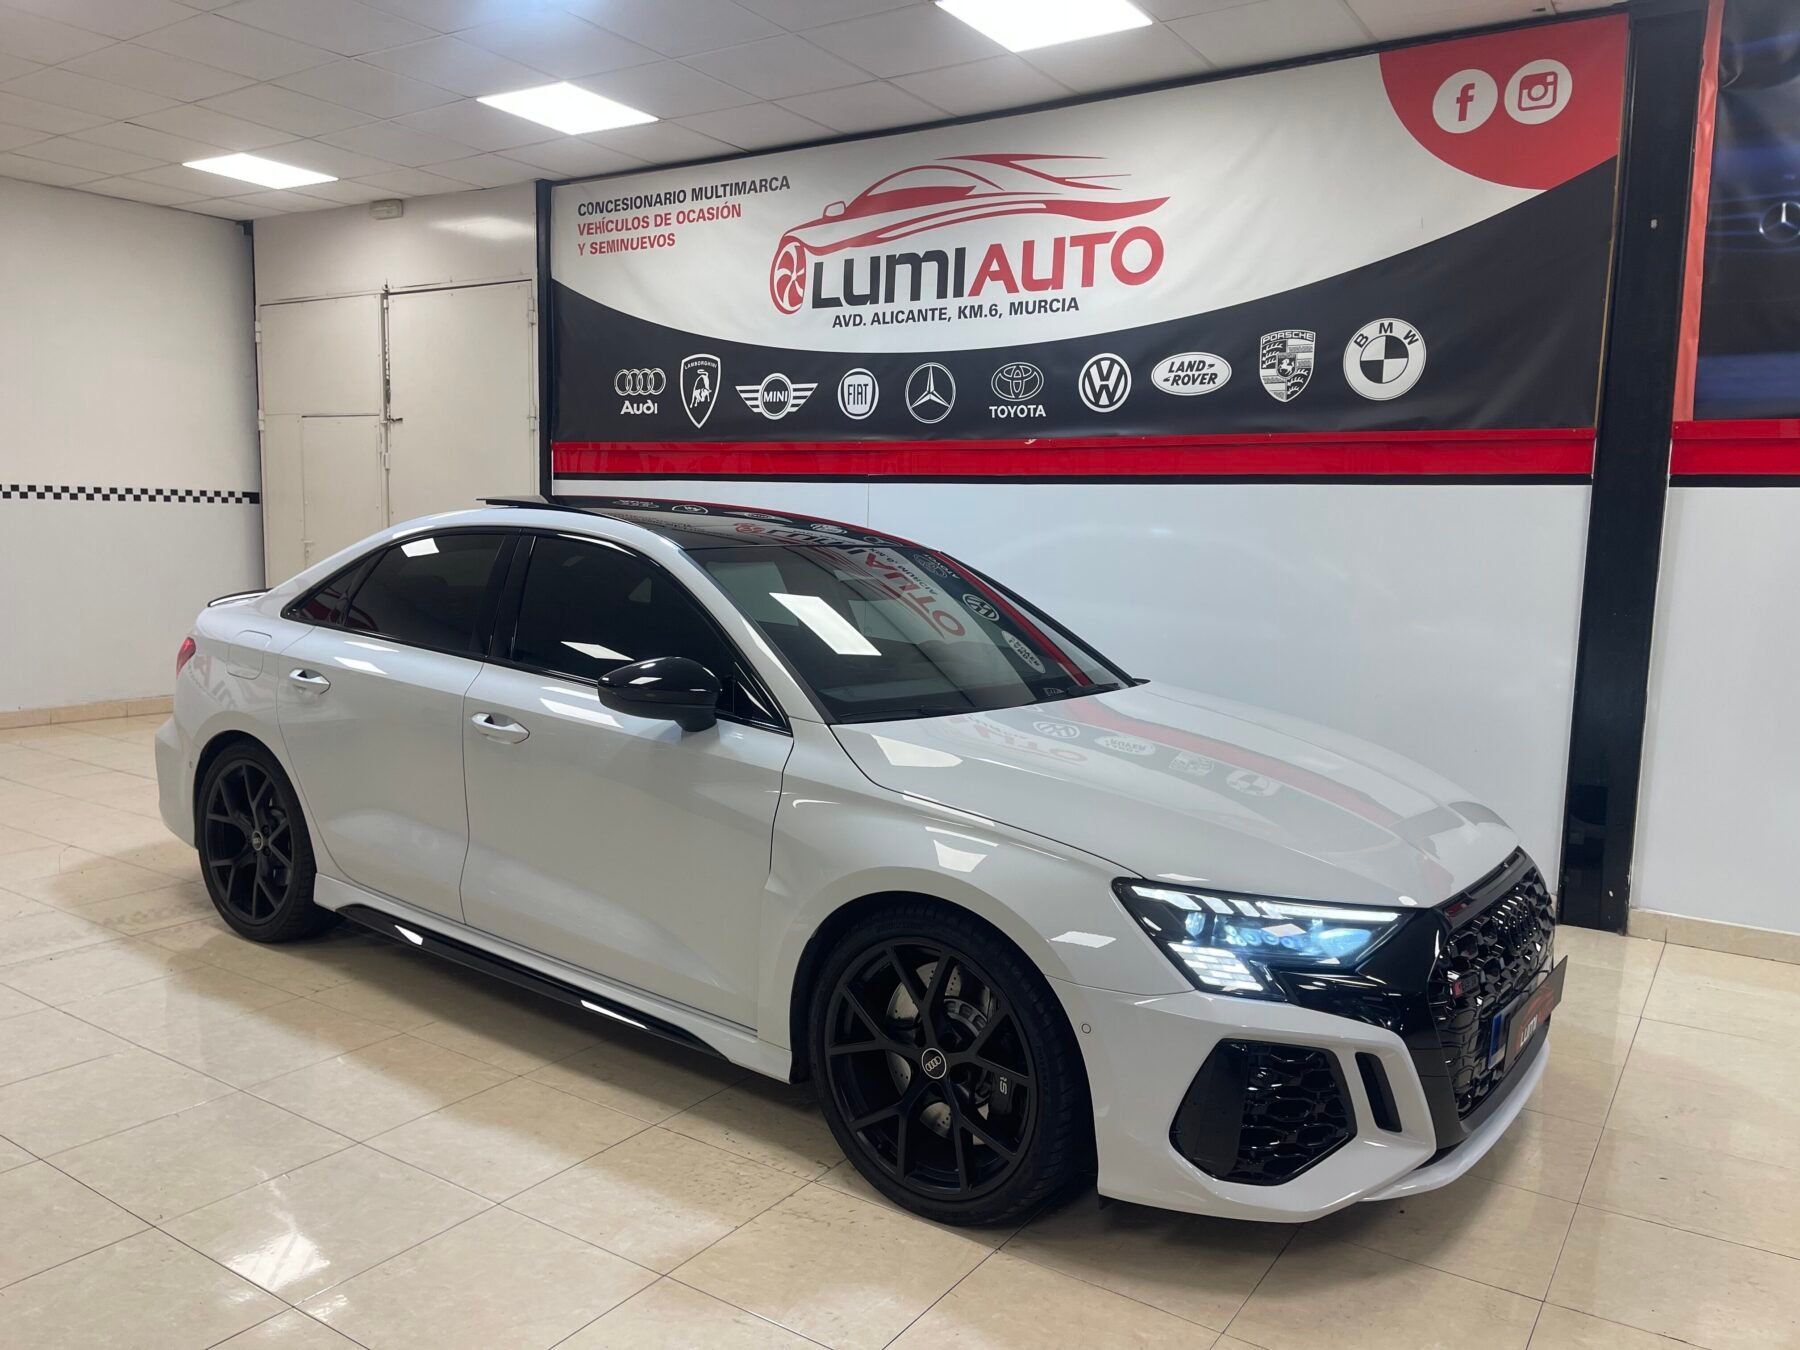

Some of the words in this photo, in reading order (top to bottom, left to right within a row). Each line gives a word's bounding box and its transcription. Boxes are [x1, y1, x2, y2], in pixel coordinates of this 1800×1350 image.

[578, 189, 687, 216] CONCESIONARIO
[691, 175, 791, 202] MULTIMARCA
[578, 213, 650, 236] VEHÍCULOS
[654, 213, 672, 227] DE
[676, 202, 742, 224] OCASIÓN
[578, 243, 585, 256] Y
[590, 232, 676, 255] SEMINUEVOS
[832, 313, 866, 328] AVD.
[871, 306, 952, 326] ALICANTE,
[957, 303, 1003, 320] KM.6,
[1009, 297, 1080, 316] MURCIA
[1263, 331, 1313, 344] PORSCHE
[1354, 321, 1419, 348] BMW
[763, 390, 788, 403] MINI
[847, 383, 869, 406] FIAT
[620, 399, 658, 415] Audi
[989, 404, 1046, 418] TOYOTA
